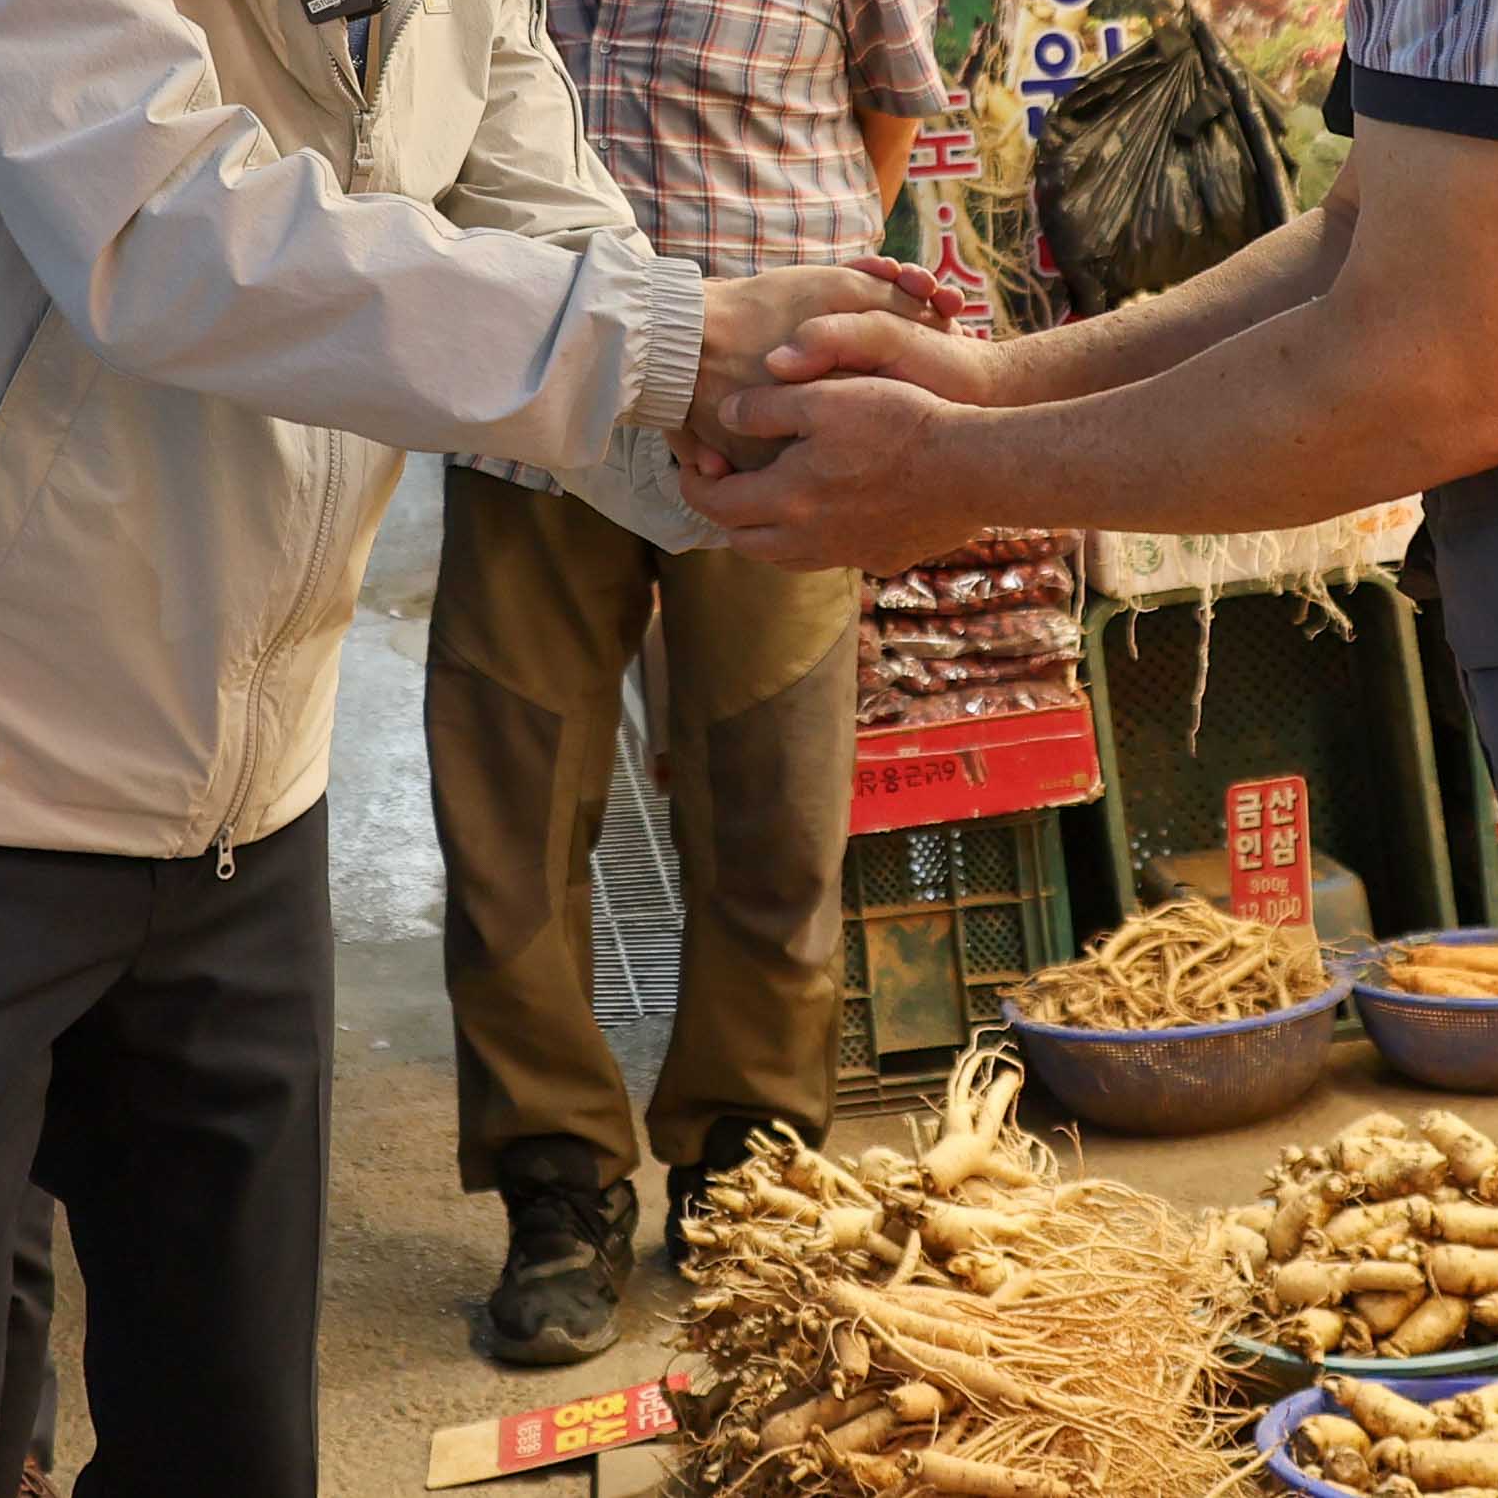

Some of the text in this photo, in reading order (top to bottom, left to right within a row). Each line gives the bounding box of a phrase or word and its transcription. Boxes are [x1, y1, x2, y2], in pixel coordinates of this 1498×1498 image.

[1235, 786, 1299, 829] 금산
[1235, 829, 1300, 871] 인삼
[552, 1392, 629, 1455] 홍삼
